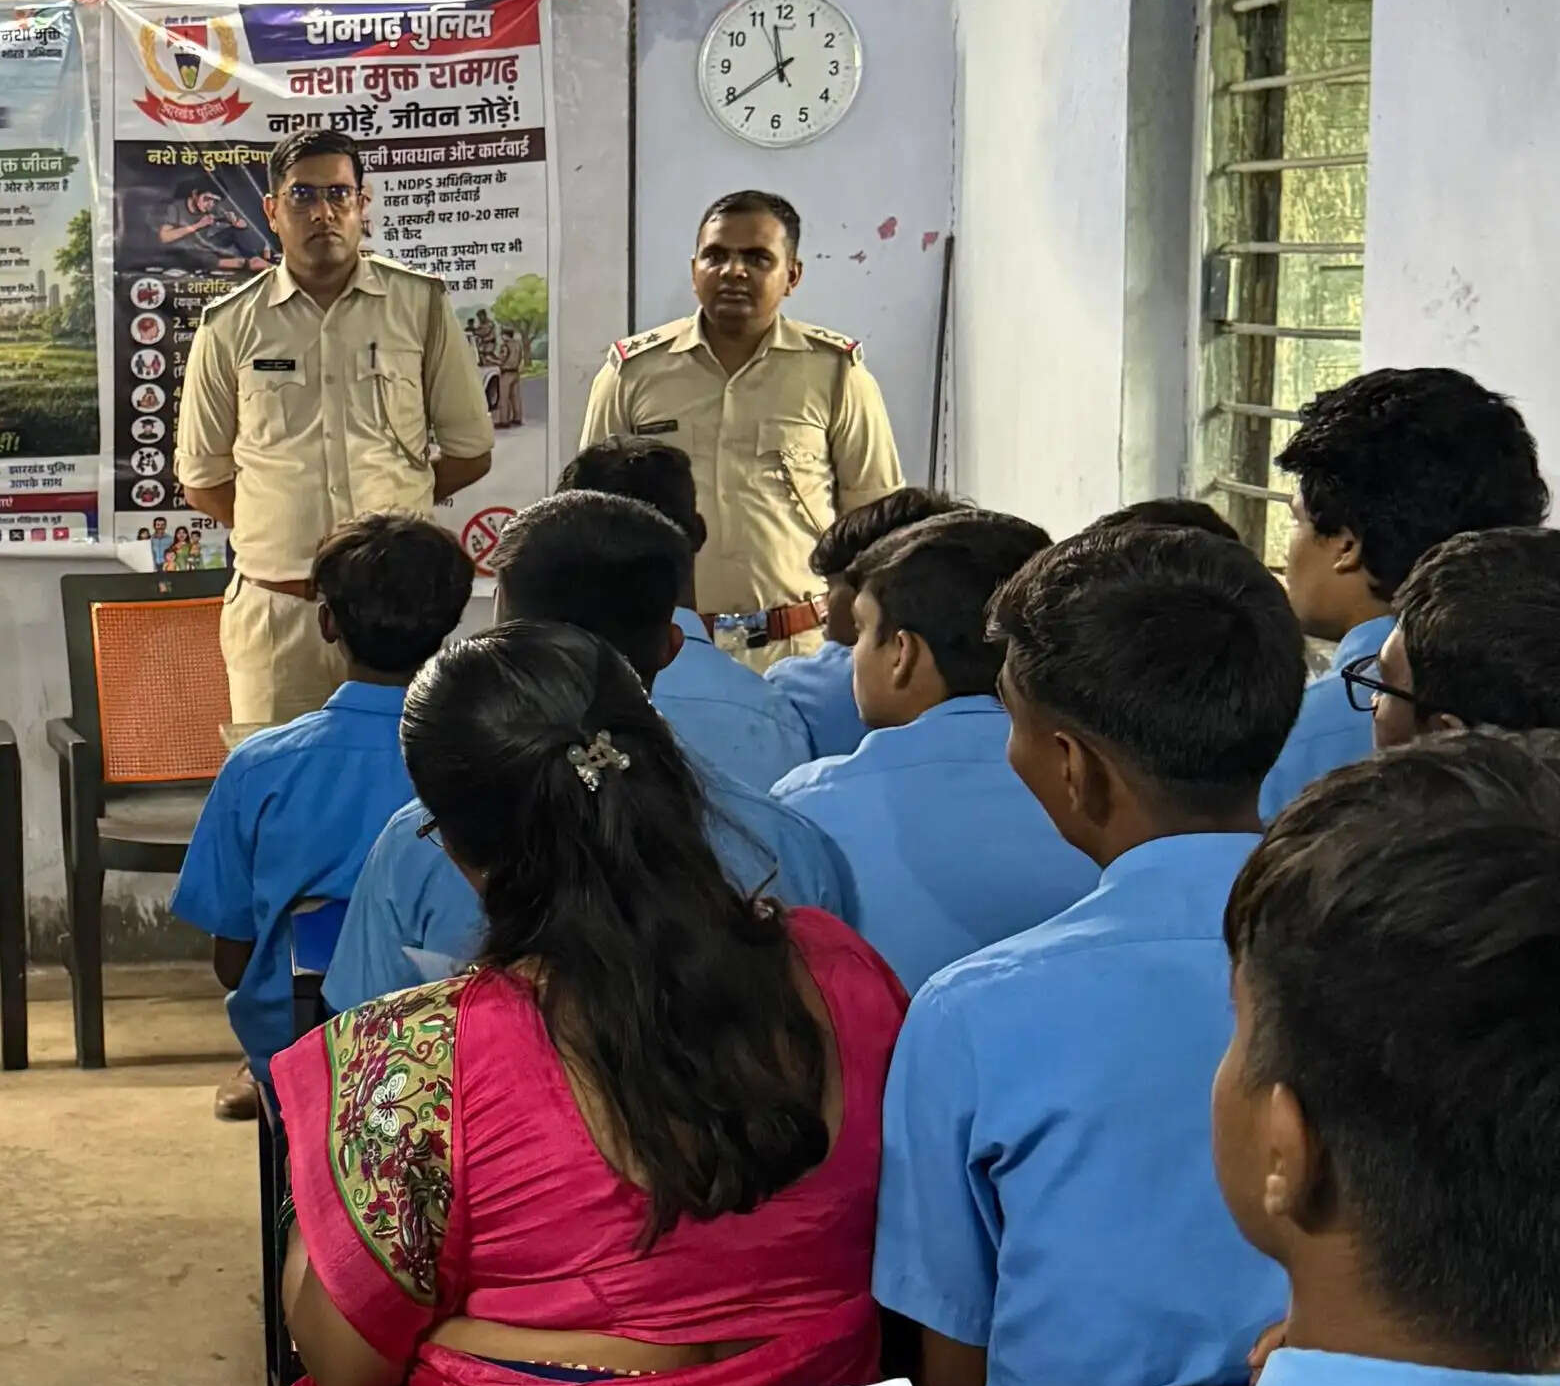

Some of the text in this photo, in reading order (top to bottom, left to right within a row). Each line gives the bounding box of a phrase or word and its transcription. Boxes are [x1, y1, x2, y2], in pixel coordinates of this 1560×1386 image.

[750, 11, 765, 27] 11
[776, 4, 794, 20] 12
[407, 3, 495, 50] पुलिस
[808, 13, 816, 28] 1
[727, 31, 746, 47] 10
[824, 32, 835, 48] 2
[721, 59, 731, 74] 9
[829, 60, 839, 76] 3
[287, 55, 519, 102] नशा मुक्त रामगढ़
[726, 86, 737, 102] 8
[820, 88, 830, 102] 4
[268, 96, 520, 136] नशा छोड़ें, जीवन जोड़ें!
[744, 106, 755, 122] 7
[770, 114, 781, 129] 6
[798, 107, 809, 122] 5
[20, 152, 62, 172] जीवन
[147, 145, 273, 172] नशे के दुष्परिणा
[358, 145, 389, 171] नूनी
[392, 147, 445, 165] प्रावधान
[448, 141, 477, 162] और
[4, 180, 22, 193] ओर
[25, 179, 34, 192] ले
[37, 181, 59, 191] जाता
[62, 178, 69, 192] है
[384, 169, 507, 191] 1. NDPS अधिनियम के
[383, 195, 409, 207] तहत
[412, 190, 436, 207] कड़ी
[383, 207, 519, 227] 2. तस्करी पर 10-20 साल
[384, 228, 399, 241] की
[401, 226, 422, 240] कैद
[450, 241, 487, 256] उपयोग
[491, 242, 506, 253] पर
[508, 238, 522, 253] भी
[431, 259, 452, 272] और
[454, 258, 476, 271] जेल
[462, 276, 477, 290] की
[480, 278, 493, 290] जा
[173, 316, 185, 328] 2.
[9, 461, 75, 475] झारखंड पुलिस
[9, 477, 63, 489] आपके साथ
